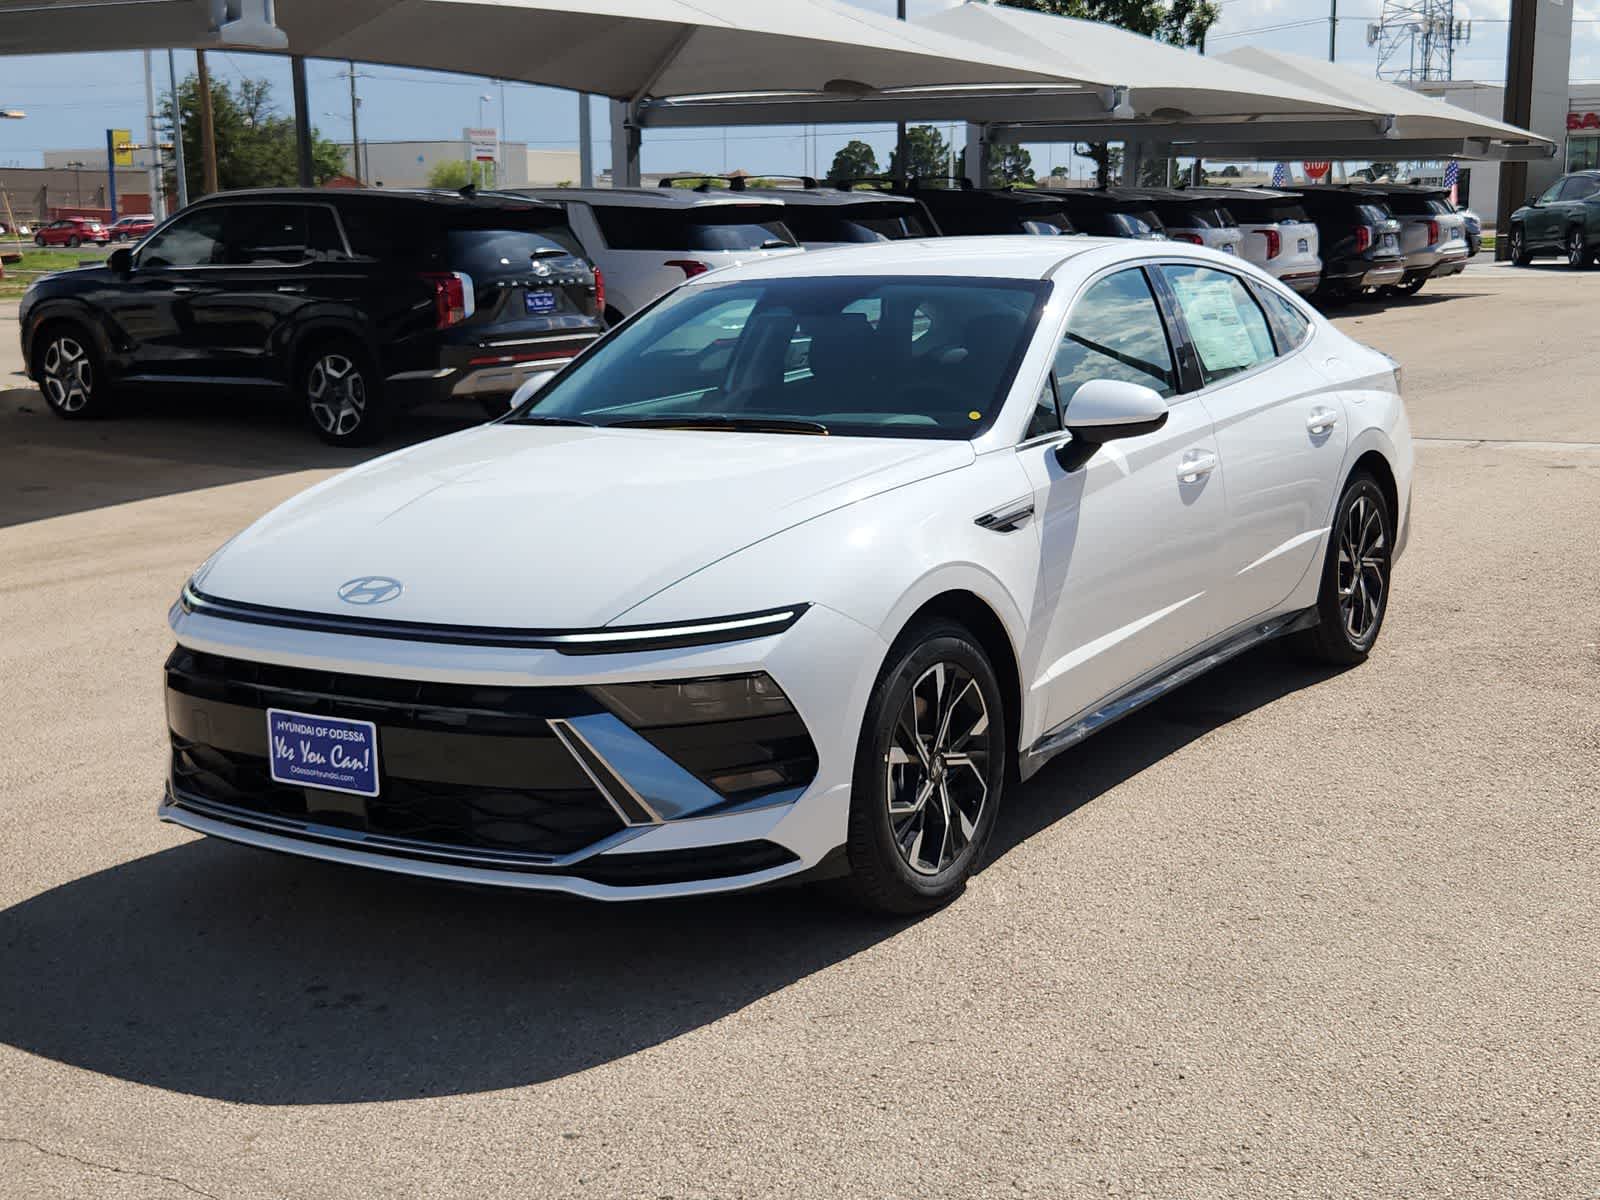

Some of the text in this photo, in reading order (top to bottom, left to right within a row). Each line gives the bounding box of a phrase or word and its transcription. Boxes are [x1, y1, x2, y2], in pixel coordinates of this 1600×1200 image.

[277, 721, 366, 743] HYUNDAI OF ODESSA
[275, 736, 370, 772] Yes You Can!
